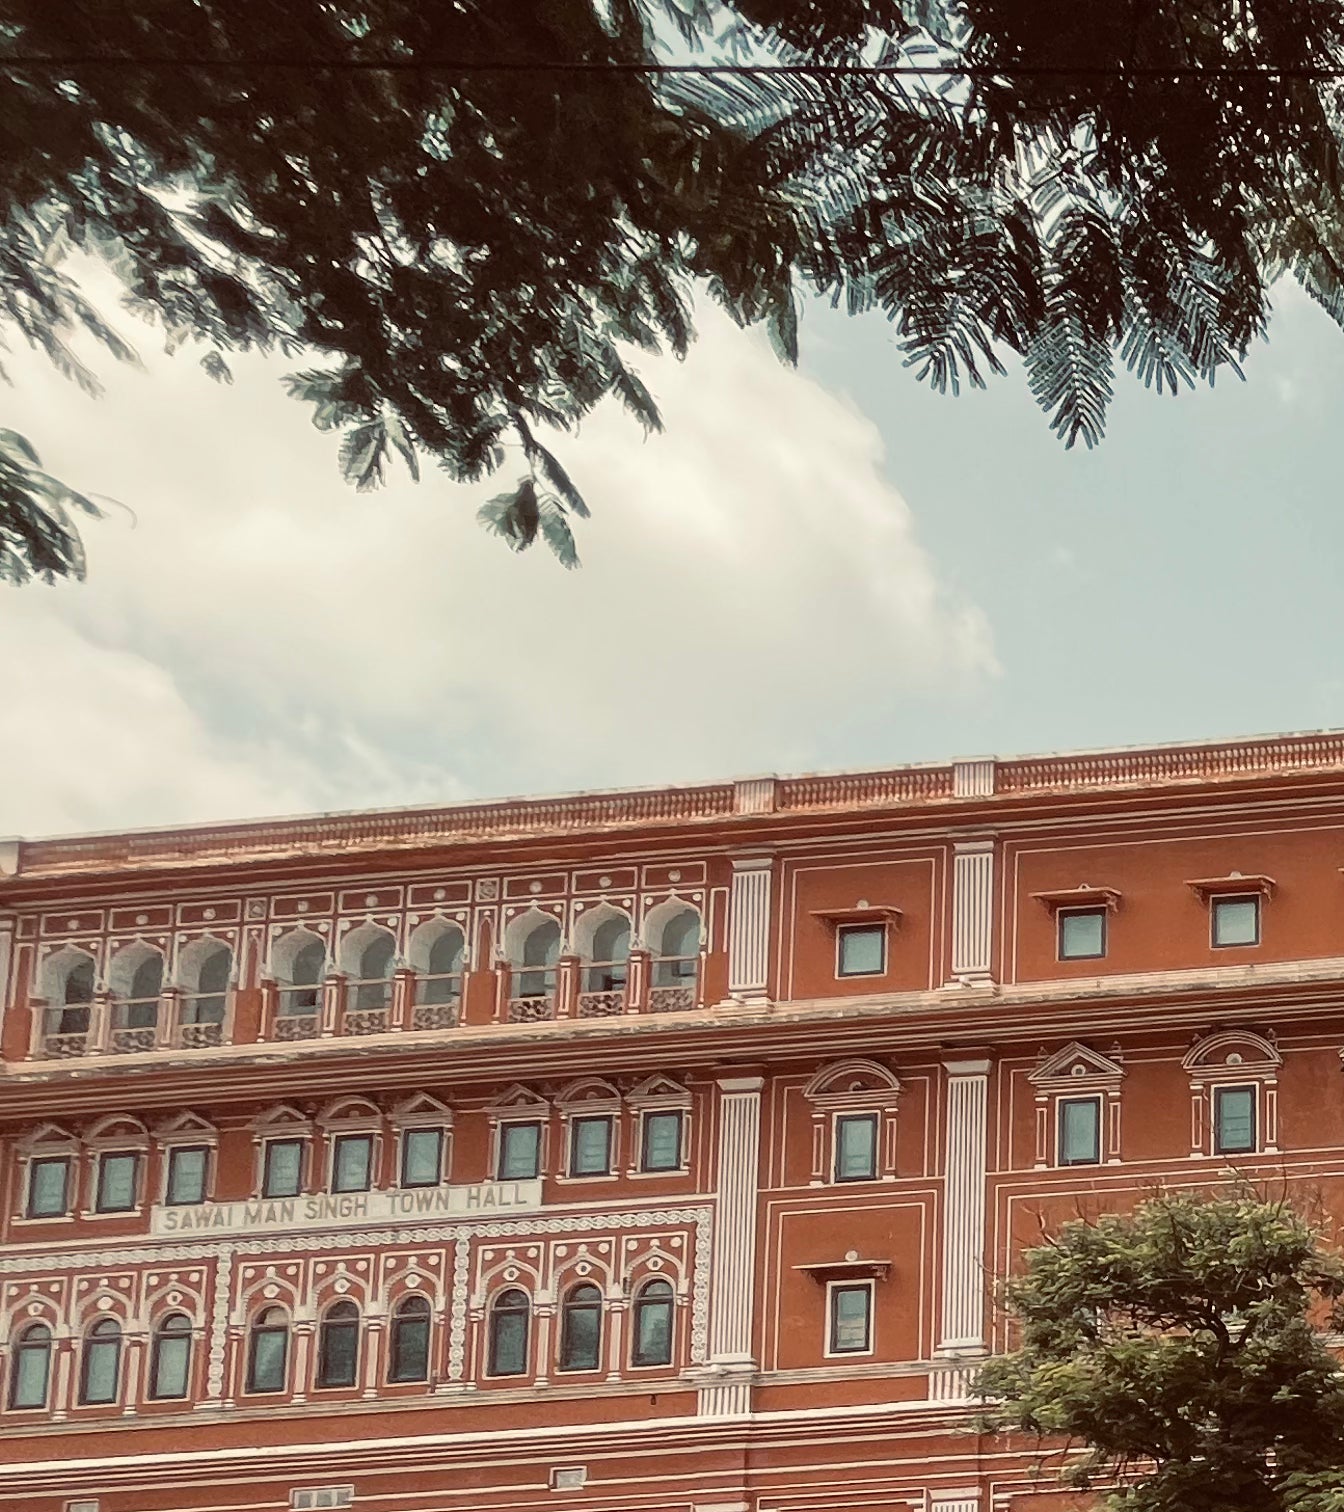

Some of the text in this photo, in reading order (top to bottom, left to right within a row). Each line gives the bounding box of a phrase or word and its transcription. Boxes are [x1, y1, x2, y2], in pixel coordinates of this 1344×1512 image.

[163, 1183, 528, 1231] SAWAI MAN SINGH TOWN HALL
